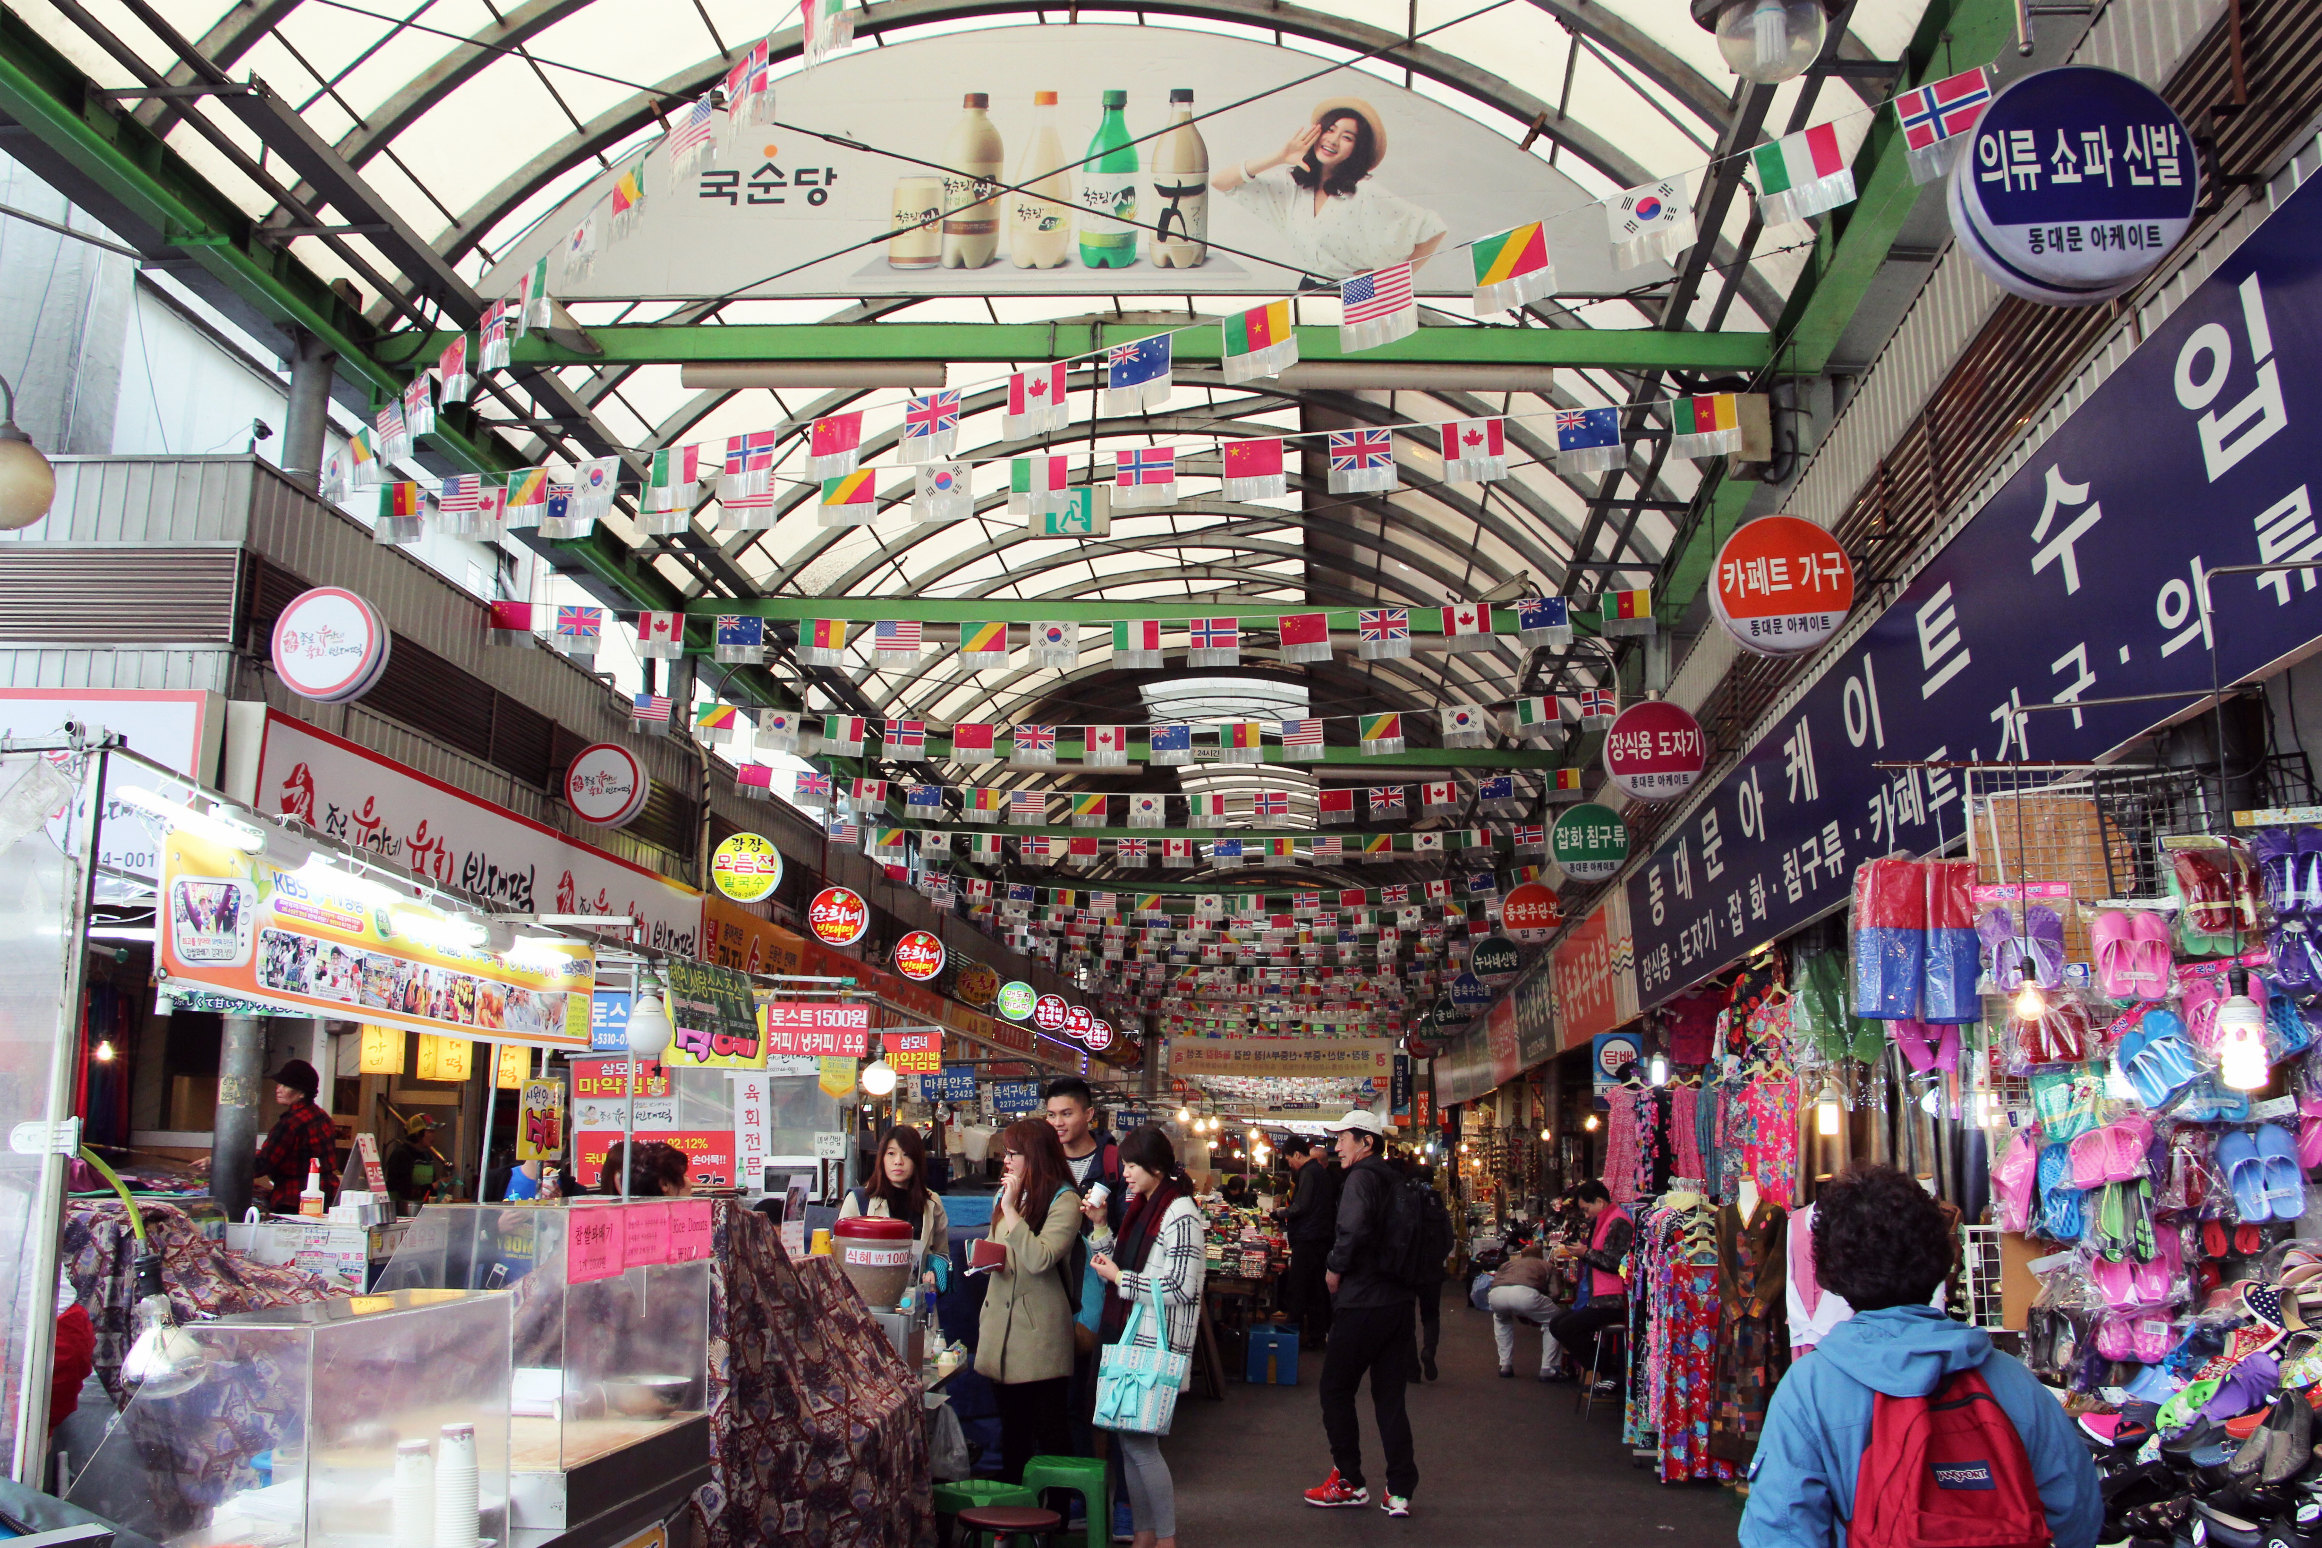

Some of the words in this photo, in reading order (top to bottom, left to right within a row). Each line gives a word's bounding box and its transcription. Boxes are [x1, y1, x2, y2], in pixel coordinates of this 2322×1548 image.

[1979, 129, 2042, 192] 의류
[2051, 125, 2114, 188] 쇼파
[2123, 123, 2183, 186] 신발
[699, 166, 838, 207] 국순당
[2028, 225, 2083, 254] 동대문
[2091, 222, 2163, 251] 아케이트
[1722, 556, 1793, 598] 카페트
[1798, 552, 1845, 593] 가구
[1648, 806, 1724, 927] 동대문
[1738, 580, 1972, 843] 아케이트
[2031, 270, 2289, 596] 수입
[1750, 618, 1783, 637] 동대문
[1787, 615, 1831, 633] 아케이트
[1610, 730, 1653, 762] 장식용
[1658, 728, 1701, 757] 도자기
[1642, 942, 1671, 992] 장식용
[1680, 908, 1717, 967] 도자기
[1727, 873, 1768, 938] 잡화
[1783, 819, 1846, 905] 침구류
[1868, 745, 1959, 844] 카페트
[1990, 641, 2097, 763] 가구
[2156, 483, 2322, 659] 의류
[1631, 774, 1655, 788] 동대문
[1657, 773, 1690, 786] 아케이트
[731, 837, 764, 852] 광장
[1556, 825, 1584, 850] 잡화
[1587, 825, 1627, 849] 침구류
[714, 853, 776, 875] 모듬전
[1569, 862, 1589, 873] 동대문
[723, 875, 765, 889] 칼국수
[810, 903, 863, 926] 순희네
[816, 923, 855, 939] 빈대떡
[896, 944, 941, 964] 순희네
[901, 961, 934, 975] 빈대떡
[771, 1009, 813, 1028] 토스트
[814, 1009, 868, 1029] 1500원
[770, 1034, 792, 1052] 커피
[801, 1033, 834, 1053] 냉커피
[842, 1035, 865, 1053] 우유
[900, 1035, 928, 1050] 삼모녀
[885, 1051, 941, 1072] 마약김밥
[1604, 1051, 1633, 1065] 담배
[924, 1076, 974, 1089] 마른안주
[744, 1084, 763, 1176] 육회전문
[847, 1250, 872, 1265] 식혜
